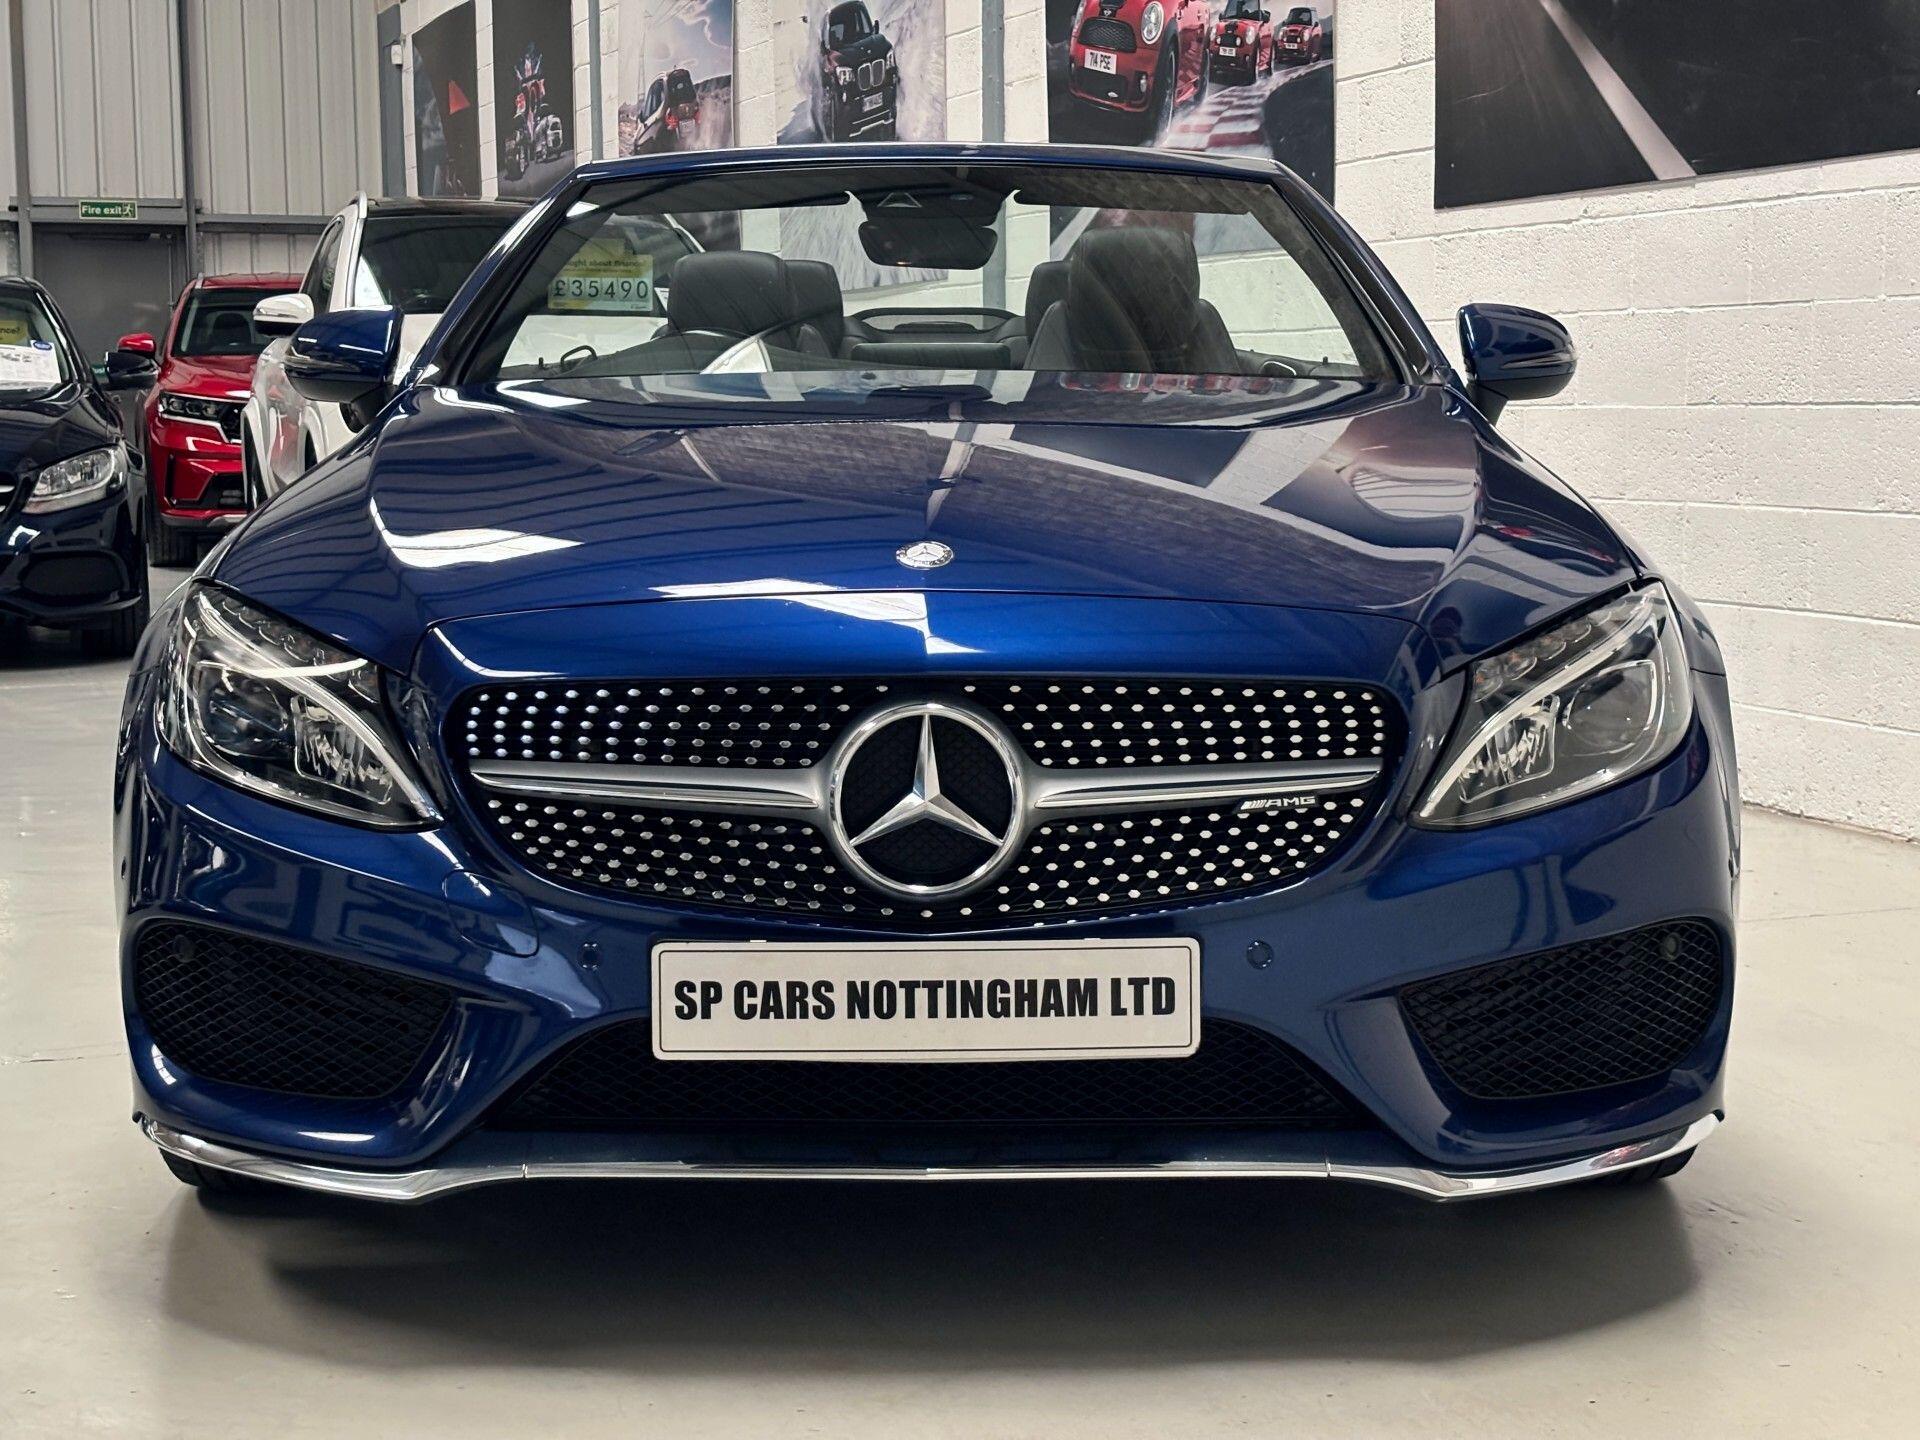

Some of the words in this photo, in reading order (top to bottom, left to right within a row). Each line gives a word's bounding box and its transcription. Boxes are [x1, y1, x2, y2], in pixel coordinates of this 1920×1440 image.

[82, 204, 101, 215] Fire
[103, 205, 122, 215] exit
[553, 279, 649, 299] £35490
[1264, 795, 1316, 808] AMG
[674, 980, 723, 1020] SP
[733, 979, 836, 1020] CARS
[846, 978, 1098, 1019] NOTTINGHAM
[1110, 976, 1176, 1016] LTD
